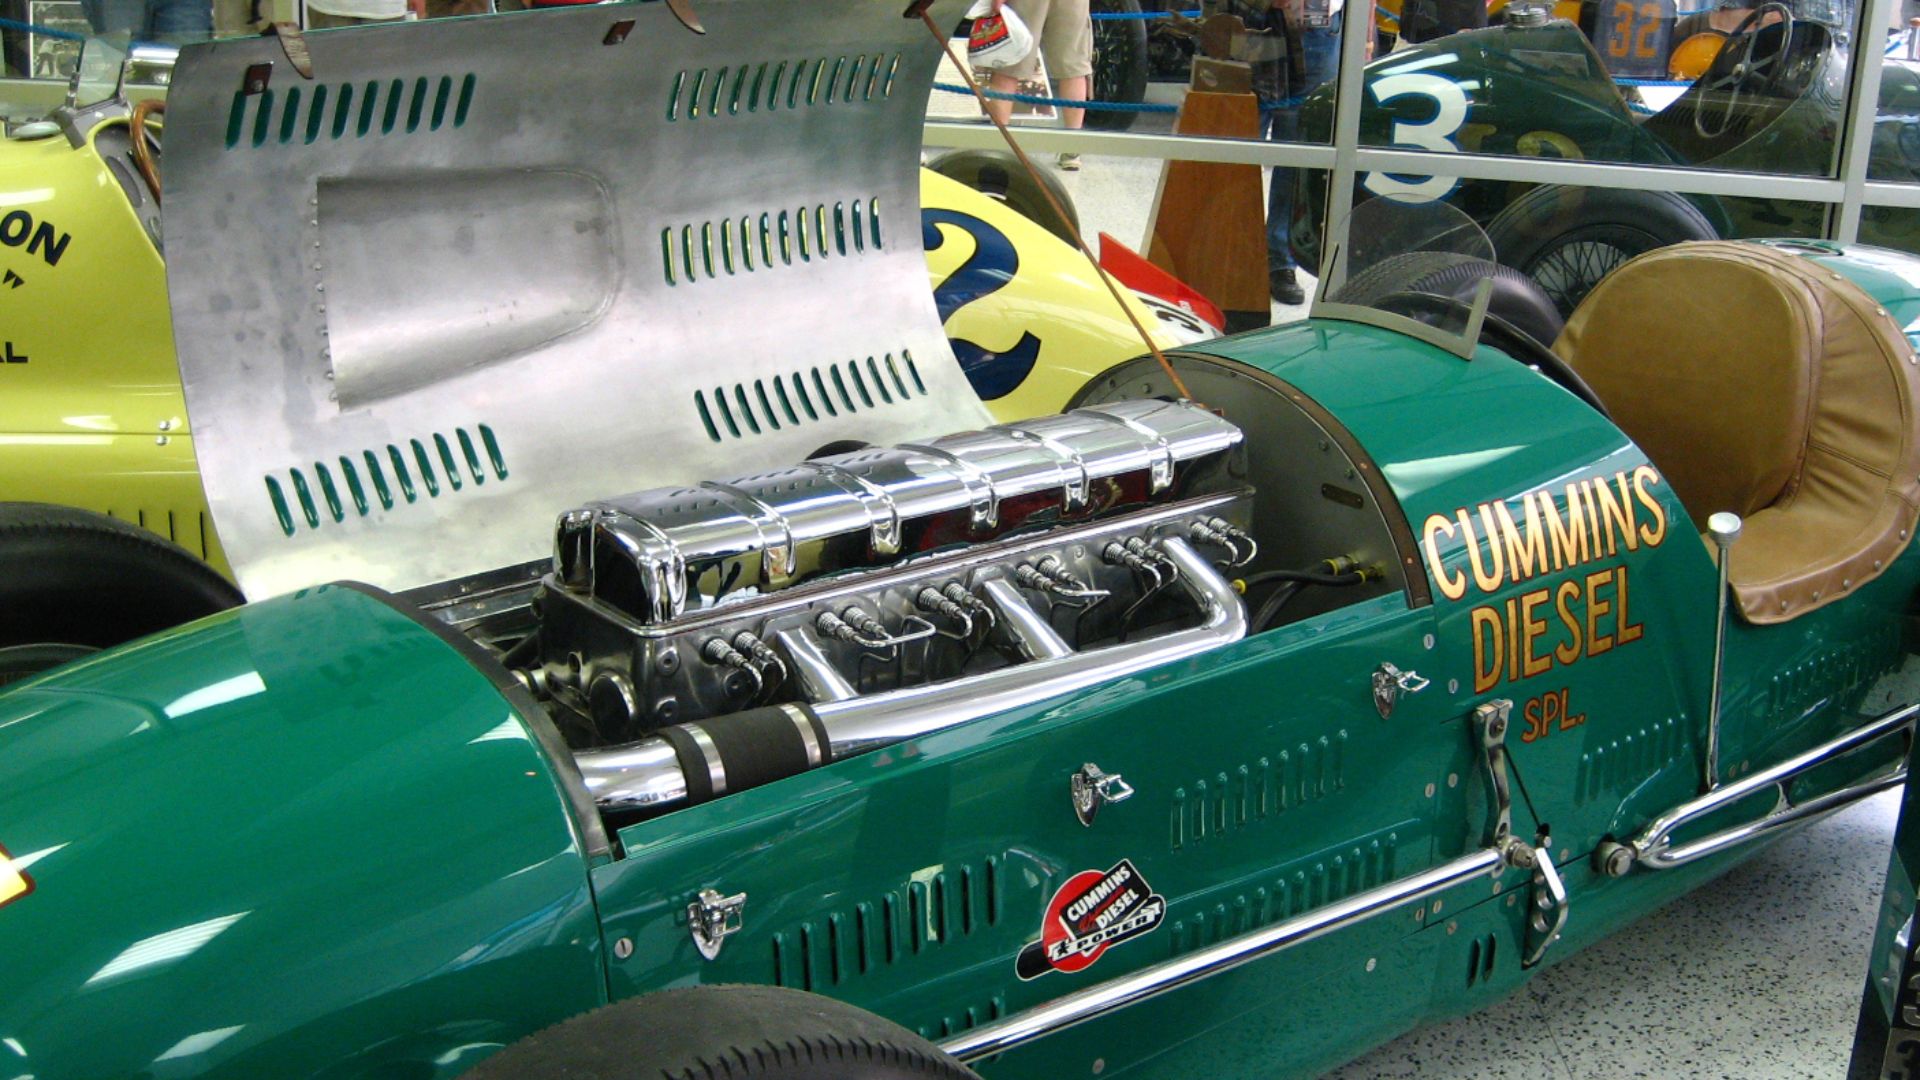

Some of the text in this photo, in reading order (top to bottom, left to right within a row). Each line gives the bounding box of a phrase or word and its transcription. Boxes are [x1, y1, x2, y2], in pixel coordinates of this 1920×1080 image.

[1609, 3, 1661, 57] 32
[1361, 71, 1471, 207] 3
[921, 207, 1041, 401] 2
[1423, 464, 1667, 600] CUMMINS
[1471, 566, 1644, 694] DIESEL
[1520, 688, 1586, 744] SPL.
[1066, 865, 1131, 922] CUMMINS
[1095, 888, 1140, 930] DIESEL
[1075, 915, 1150, 951] POWER
